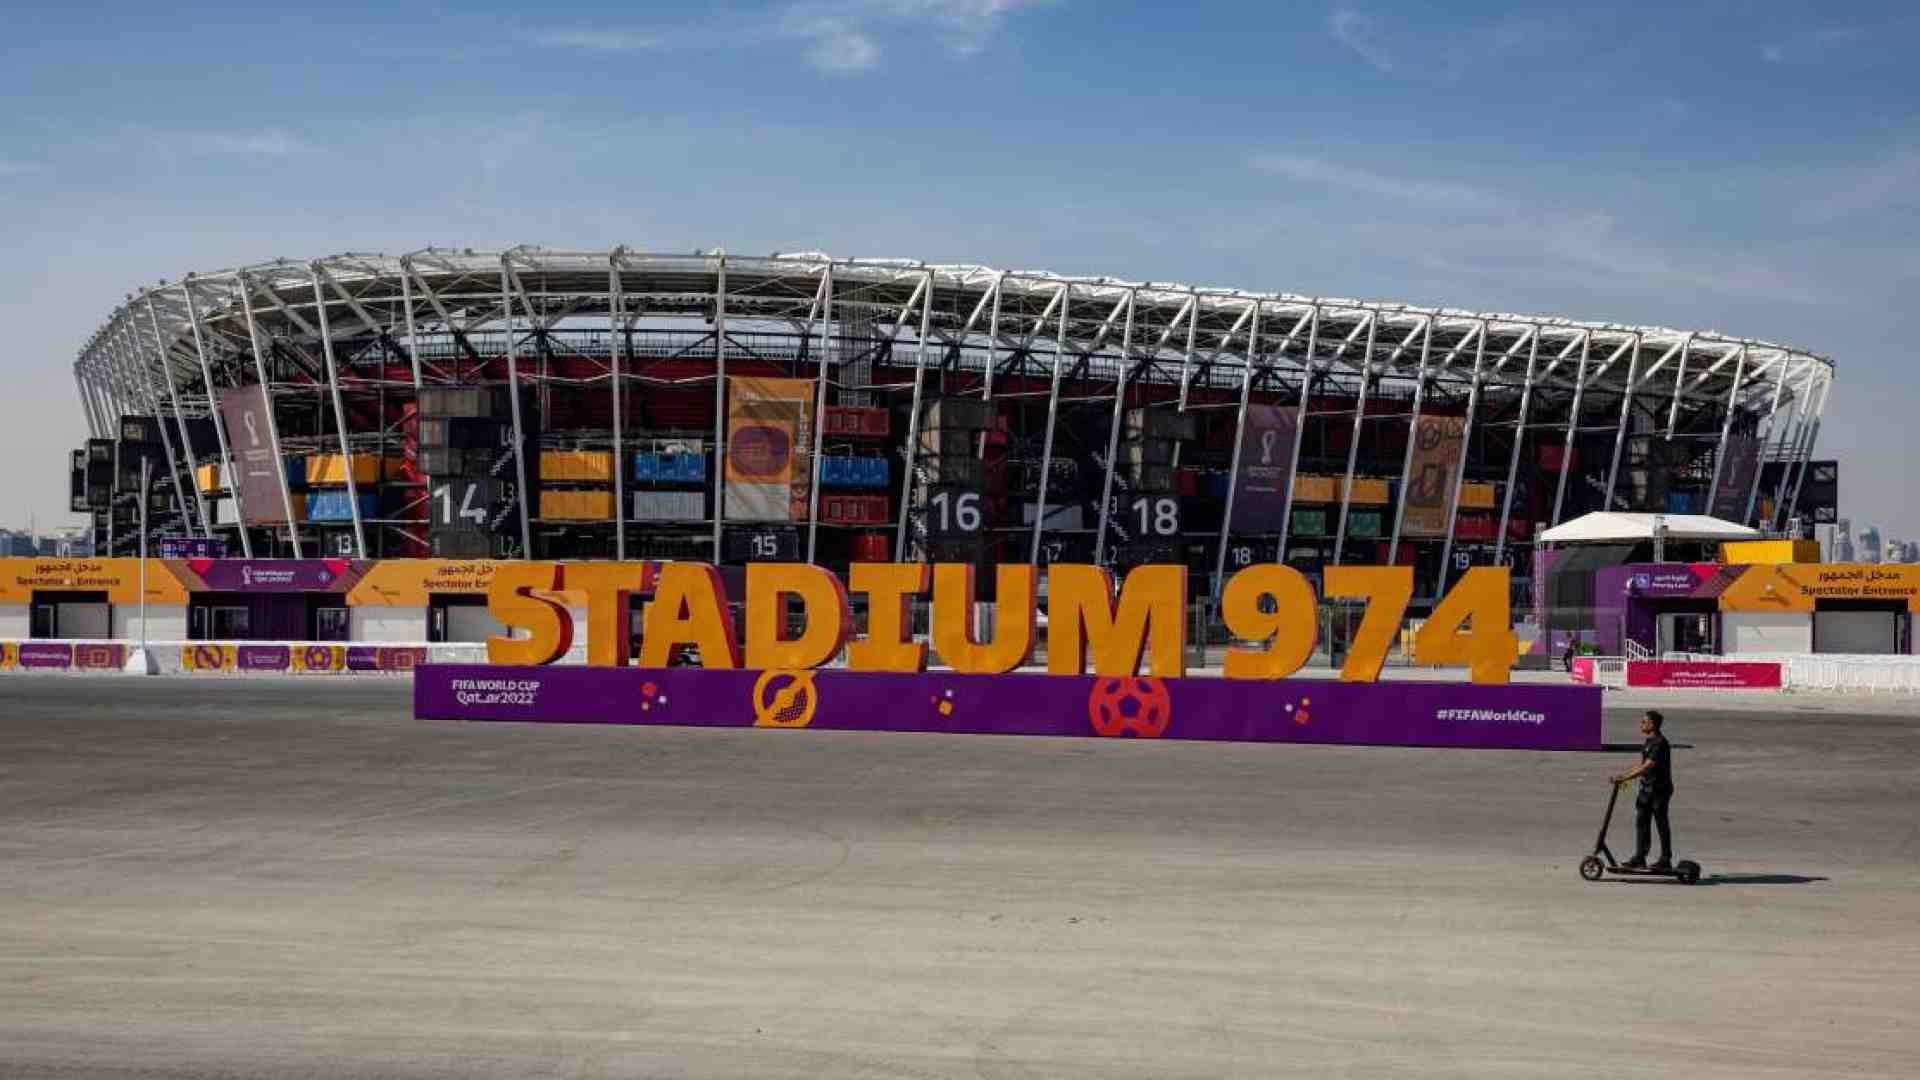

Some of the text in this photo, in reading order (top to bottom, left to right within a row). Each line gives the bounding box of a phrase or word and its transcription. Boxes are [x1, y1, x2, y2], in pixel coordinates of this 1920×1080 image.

[433, 483, 487, 524] 14
[931, 492, 981, 532] 16
[1132, 497, 1179, 536] 18
[751, 534, 777, 556] 15
[1231, 547, 1251, 566] 18
[1452, 552, 1470, 569] 19
[1800, 585, 1919, 597] Spectator Entrance
[485, 559, 1521, 684] STADIUM 974
[476, 680, 517, 690] WORLD
[1436, 708, 1546, 725] #FIFAWorldCup
